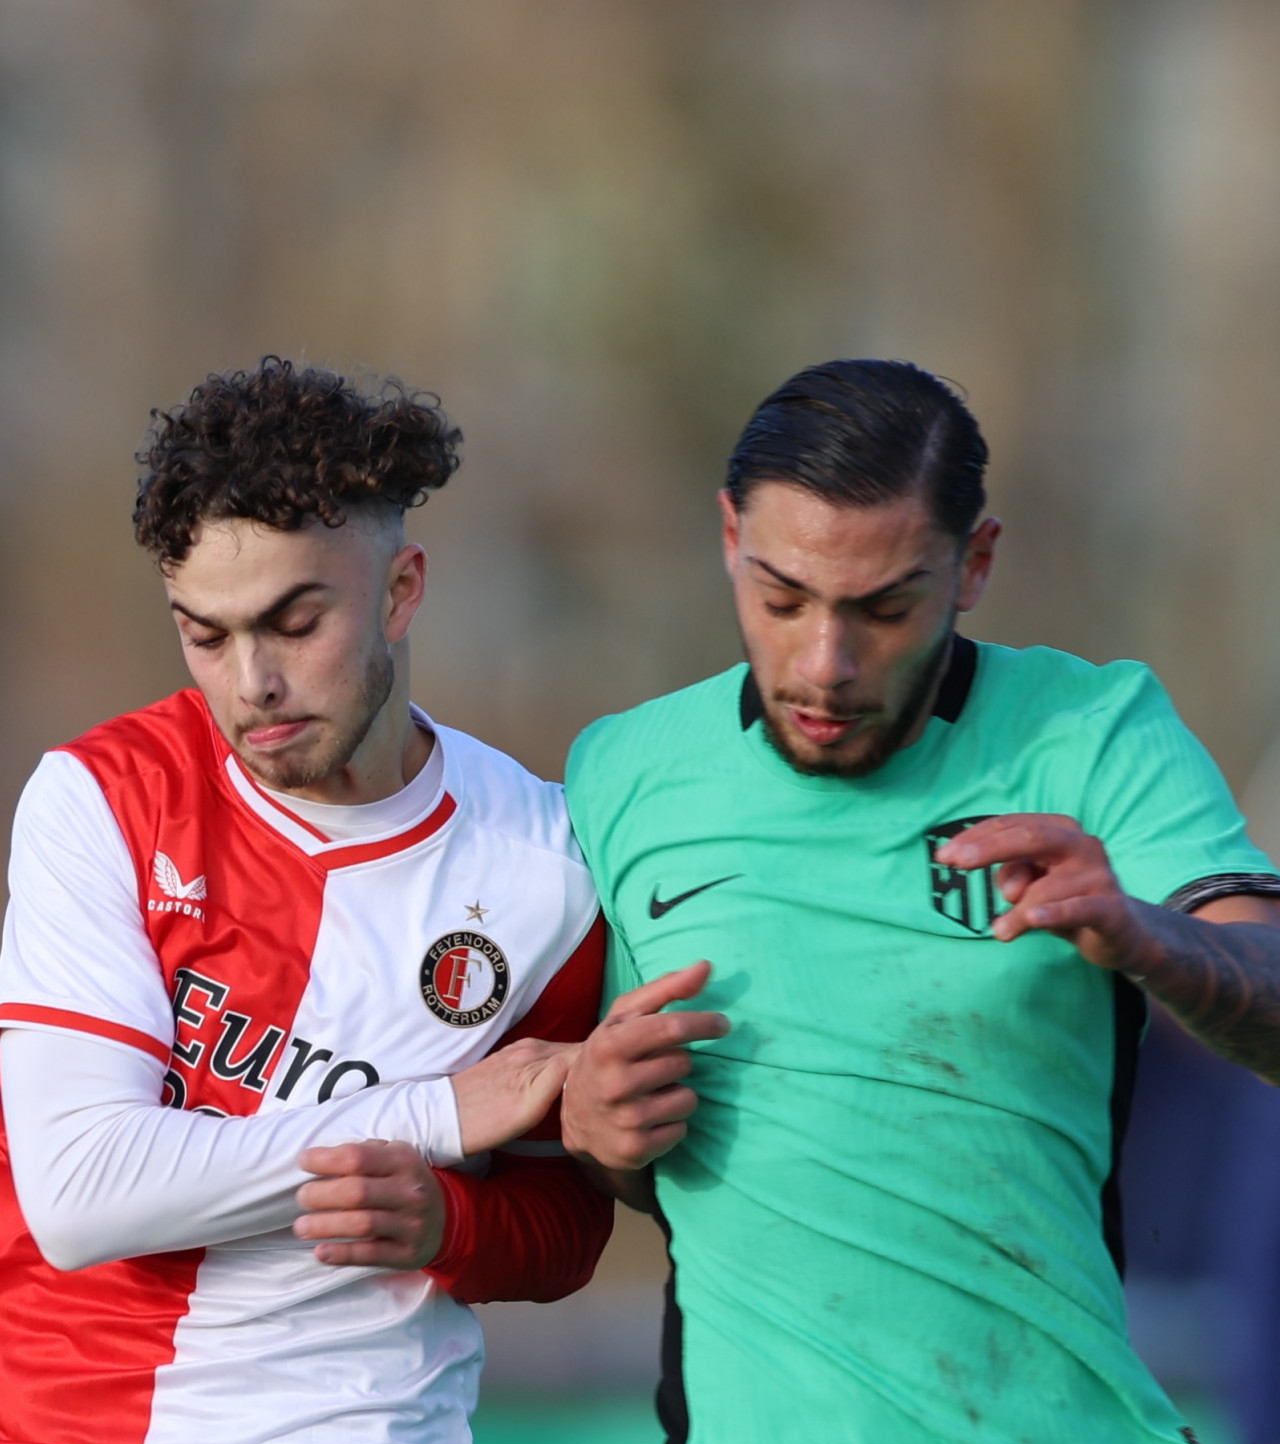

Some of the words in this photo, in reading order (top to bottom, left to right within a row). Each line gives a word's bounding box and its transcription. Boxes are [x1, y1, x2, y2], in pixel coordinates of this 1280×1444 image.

[147, 899, 205, 924] CASTOR
[429, 933, 506, 973] FEYENOORD
[443, 954, 483, 1000] F
[423, 984, 501, 1024] ROTTERDAM
